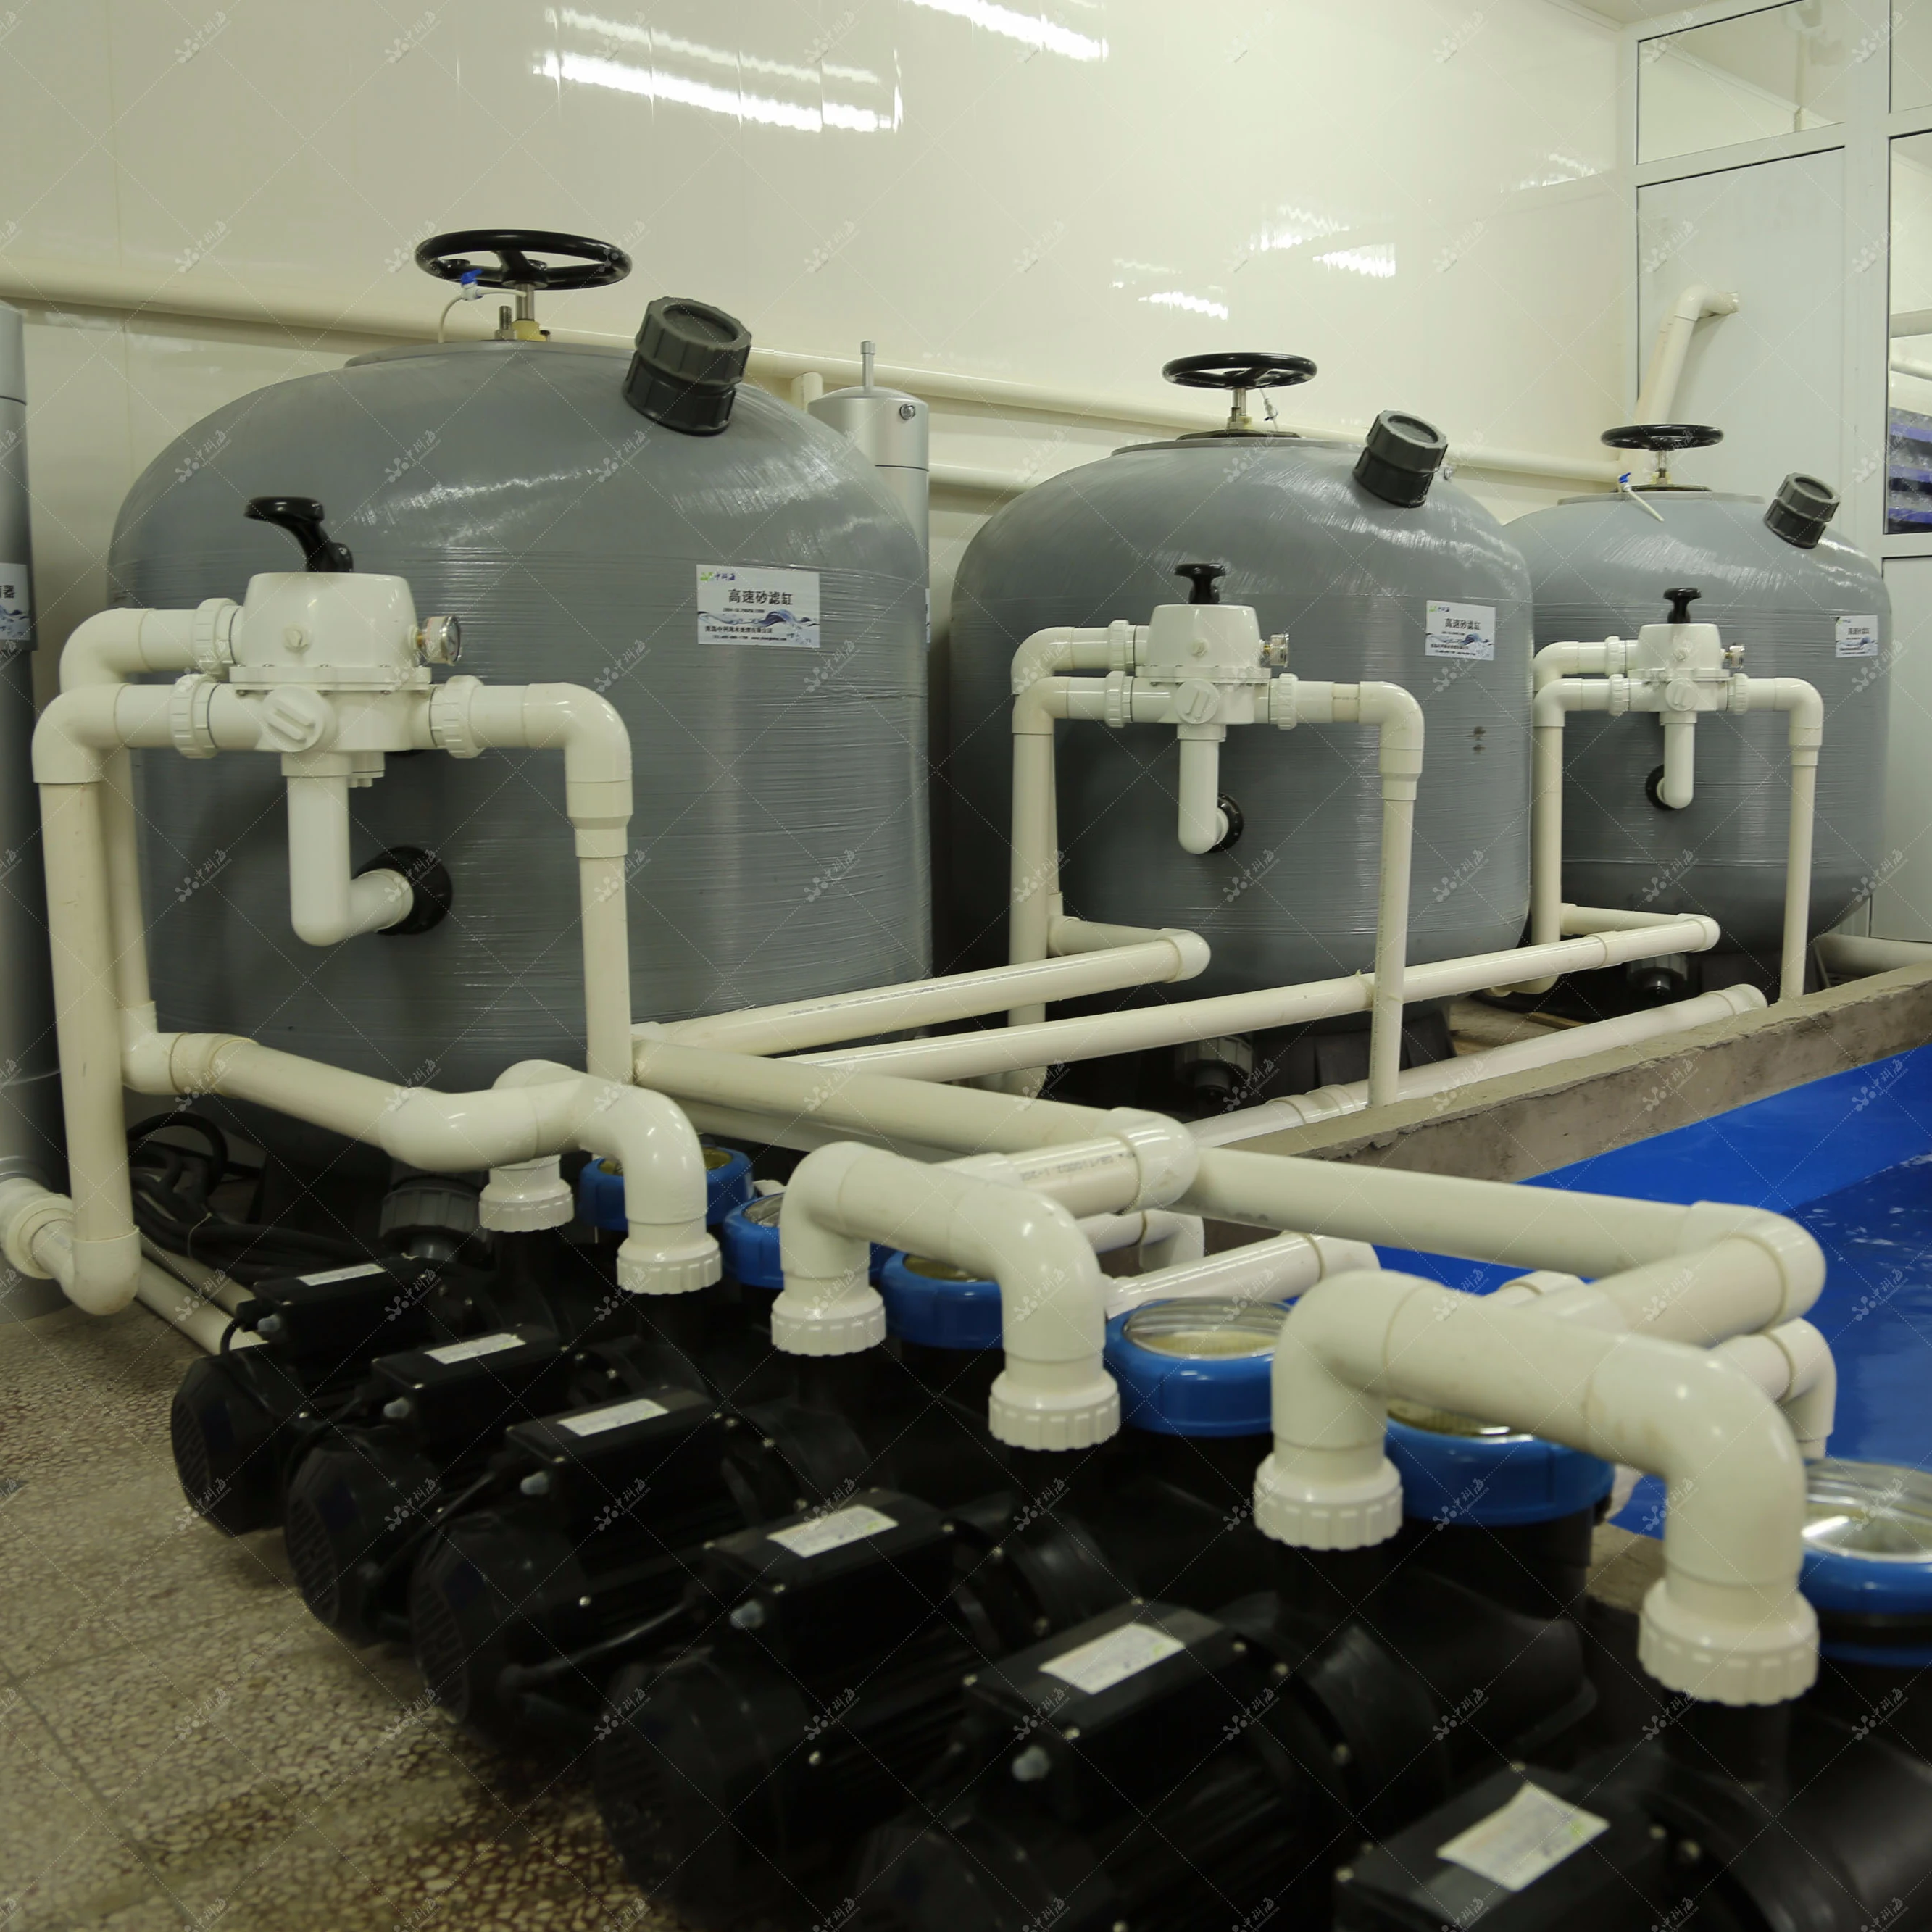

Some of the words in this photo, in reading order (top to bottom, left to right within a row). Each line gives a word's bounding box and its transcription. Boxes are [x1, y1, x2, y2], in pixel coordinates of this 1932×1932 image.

[728, 589, 793, 605] 高速砂滤缸
